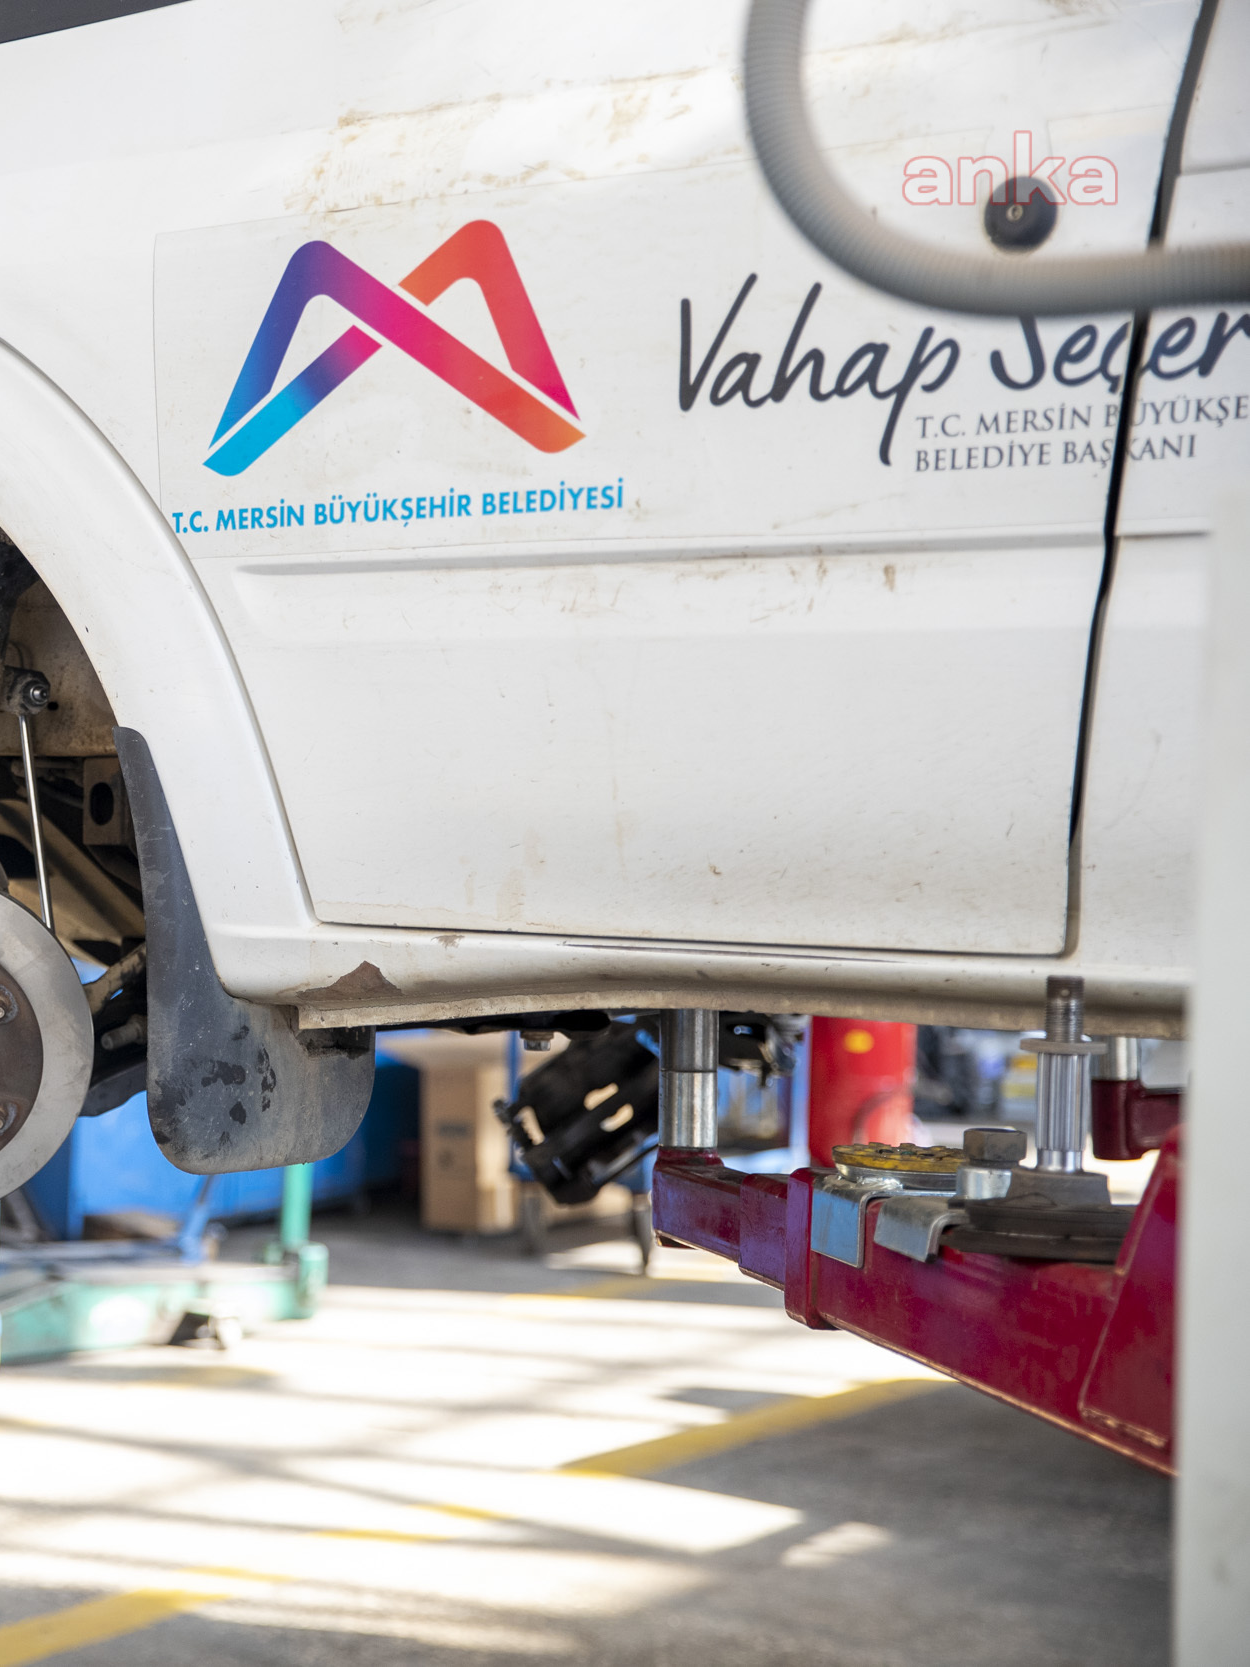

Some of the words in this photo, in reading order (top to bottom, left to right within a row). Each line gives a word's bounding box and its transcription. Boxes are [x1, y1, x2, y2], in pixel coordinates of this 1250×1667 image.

[679, 272, 960, 466] Vahap
[916, 414, 967, 438] T.C.
[976, 402, 1093, 435] MERSİN
[915, 440, 1052, 472] BELEDİYE
[172, 510, 209, 533] T.C.
[215, 498, 305, 532] MERSİN
[313, 486, 473, 528] BÜYÜKŞEHİR
[481, 476, 625, 516] BELEDİYESİ
